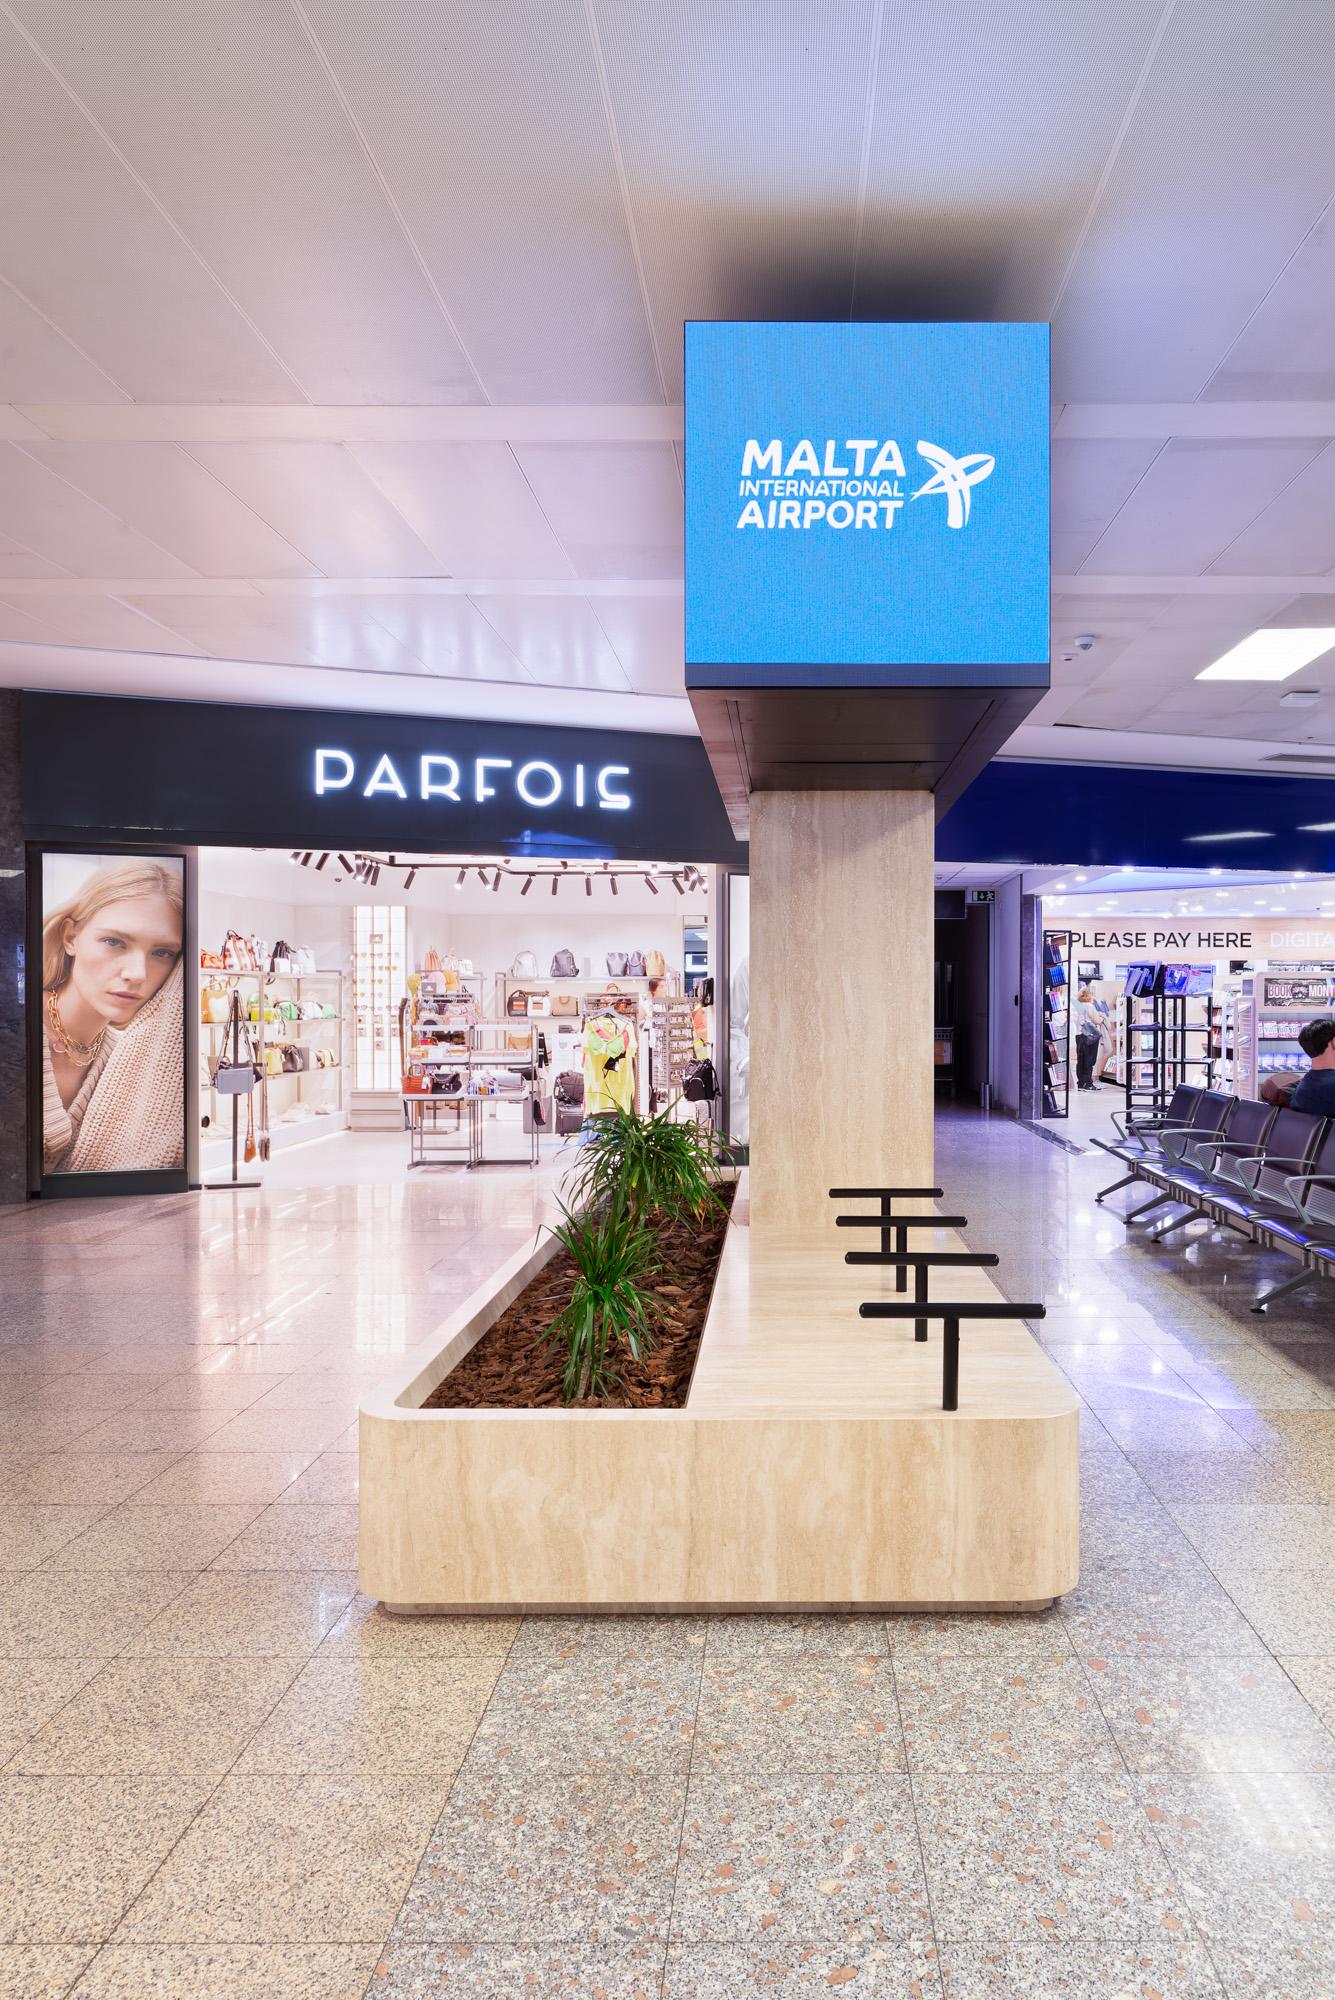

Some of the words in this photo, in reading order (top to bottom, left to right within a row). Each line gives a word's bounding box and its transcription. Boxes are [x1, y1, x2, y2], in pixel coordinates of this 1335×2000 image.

[741, 440, 906, 476] MALTA
[740, 480, 904, 497] INTERNATIONAL
[737, 500, 904, 529] AIRPORT
[315, 748, 632, 810] PARFOIS
[1071, 932, 1147, 948] PLEASE
[1153, 932, 1191, 948] PAY
[1198, 932, 1252, 948] HERE
[1267, 984, 1293, 998] BOOK
